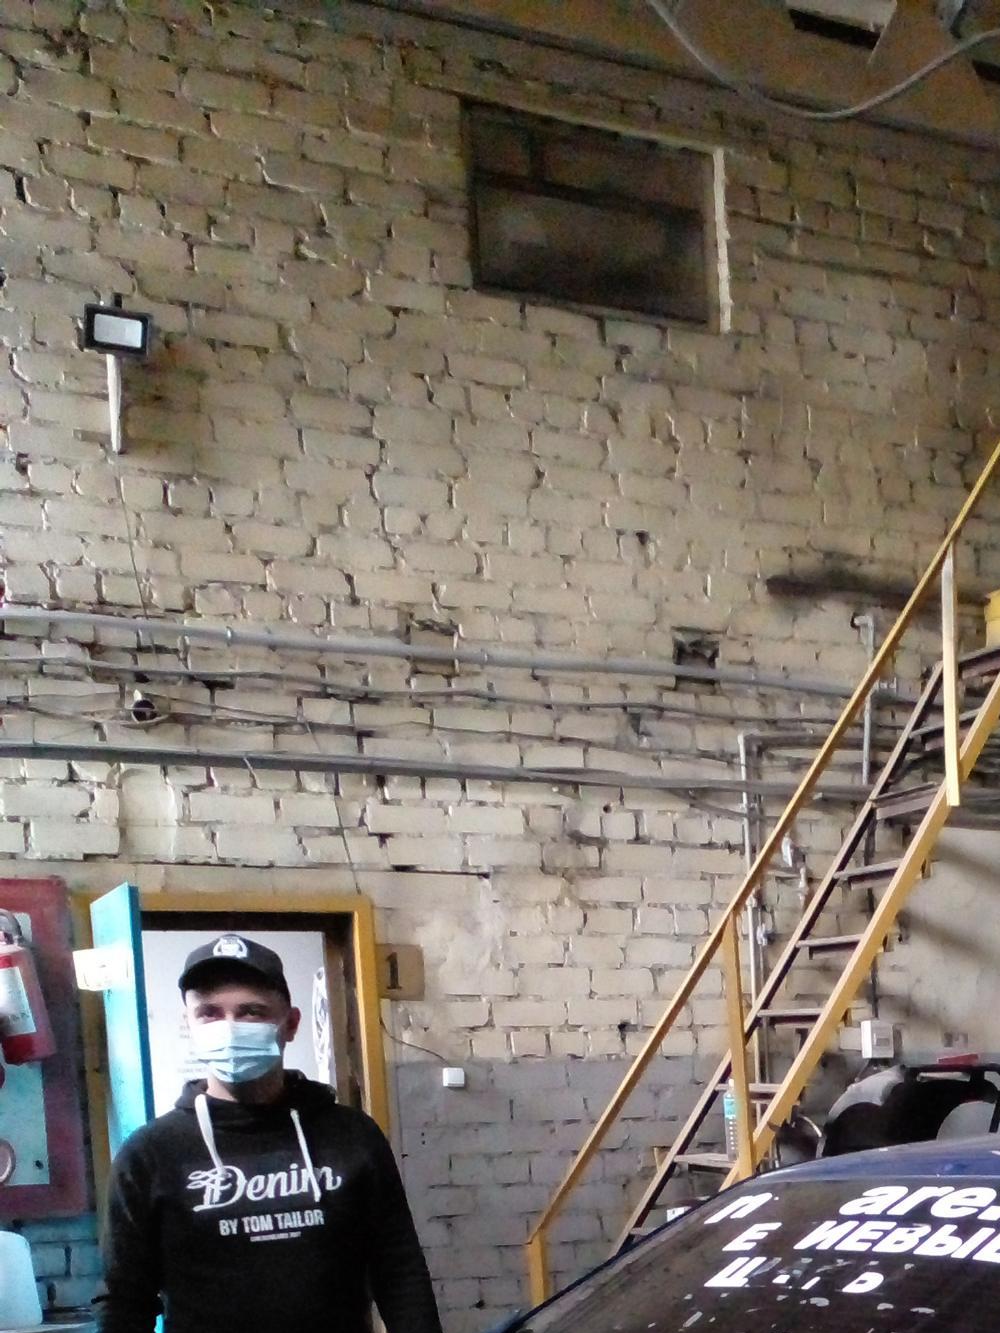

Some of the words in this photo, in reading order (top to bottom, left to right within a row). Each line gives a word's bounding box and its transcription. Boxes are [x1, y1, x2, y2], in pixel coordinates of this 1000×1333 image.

[385, 952, 403, 990] 1
[186, 1163, 342, 1212] Denim
[219, 1219, 239, 1236] BY
[242, 1214, 273, 1233] TOM
[275, 1209, 325, 1229] TAILOR
